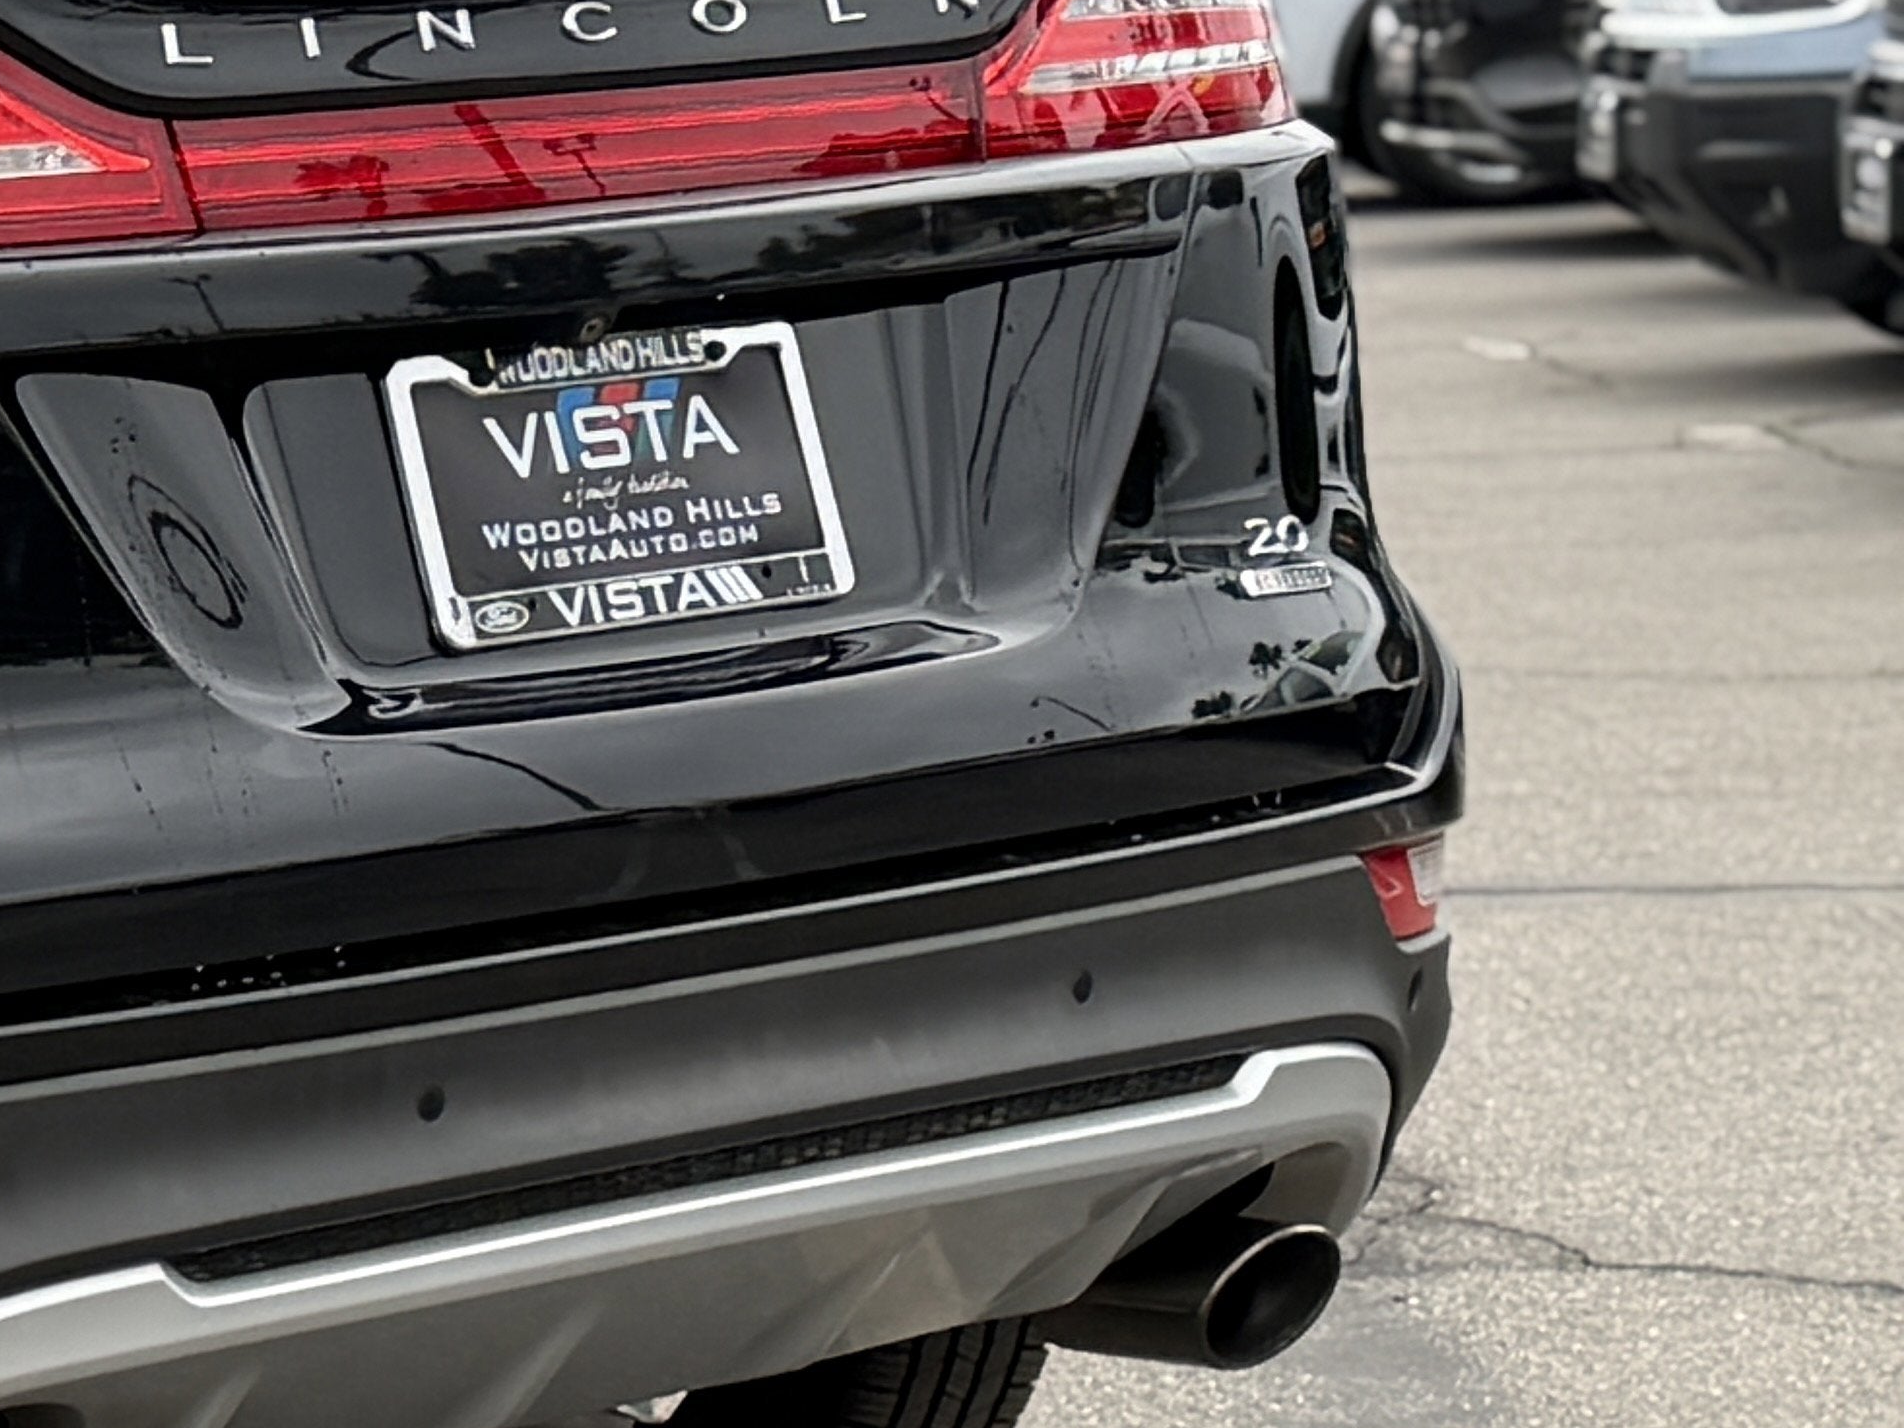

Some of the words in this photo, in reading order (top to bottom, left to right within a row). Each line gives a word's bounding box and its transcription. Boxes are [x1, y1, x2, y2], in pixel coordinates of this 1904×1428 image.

[636, 329, 706, 368] HILLS
[482, 394, 740, 479] VISTA
[481, 506, 674, 550] WOODLAND
[685, 492, 783, 525] HILLS
[546, 571, 718, 628] VISTA
